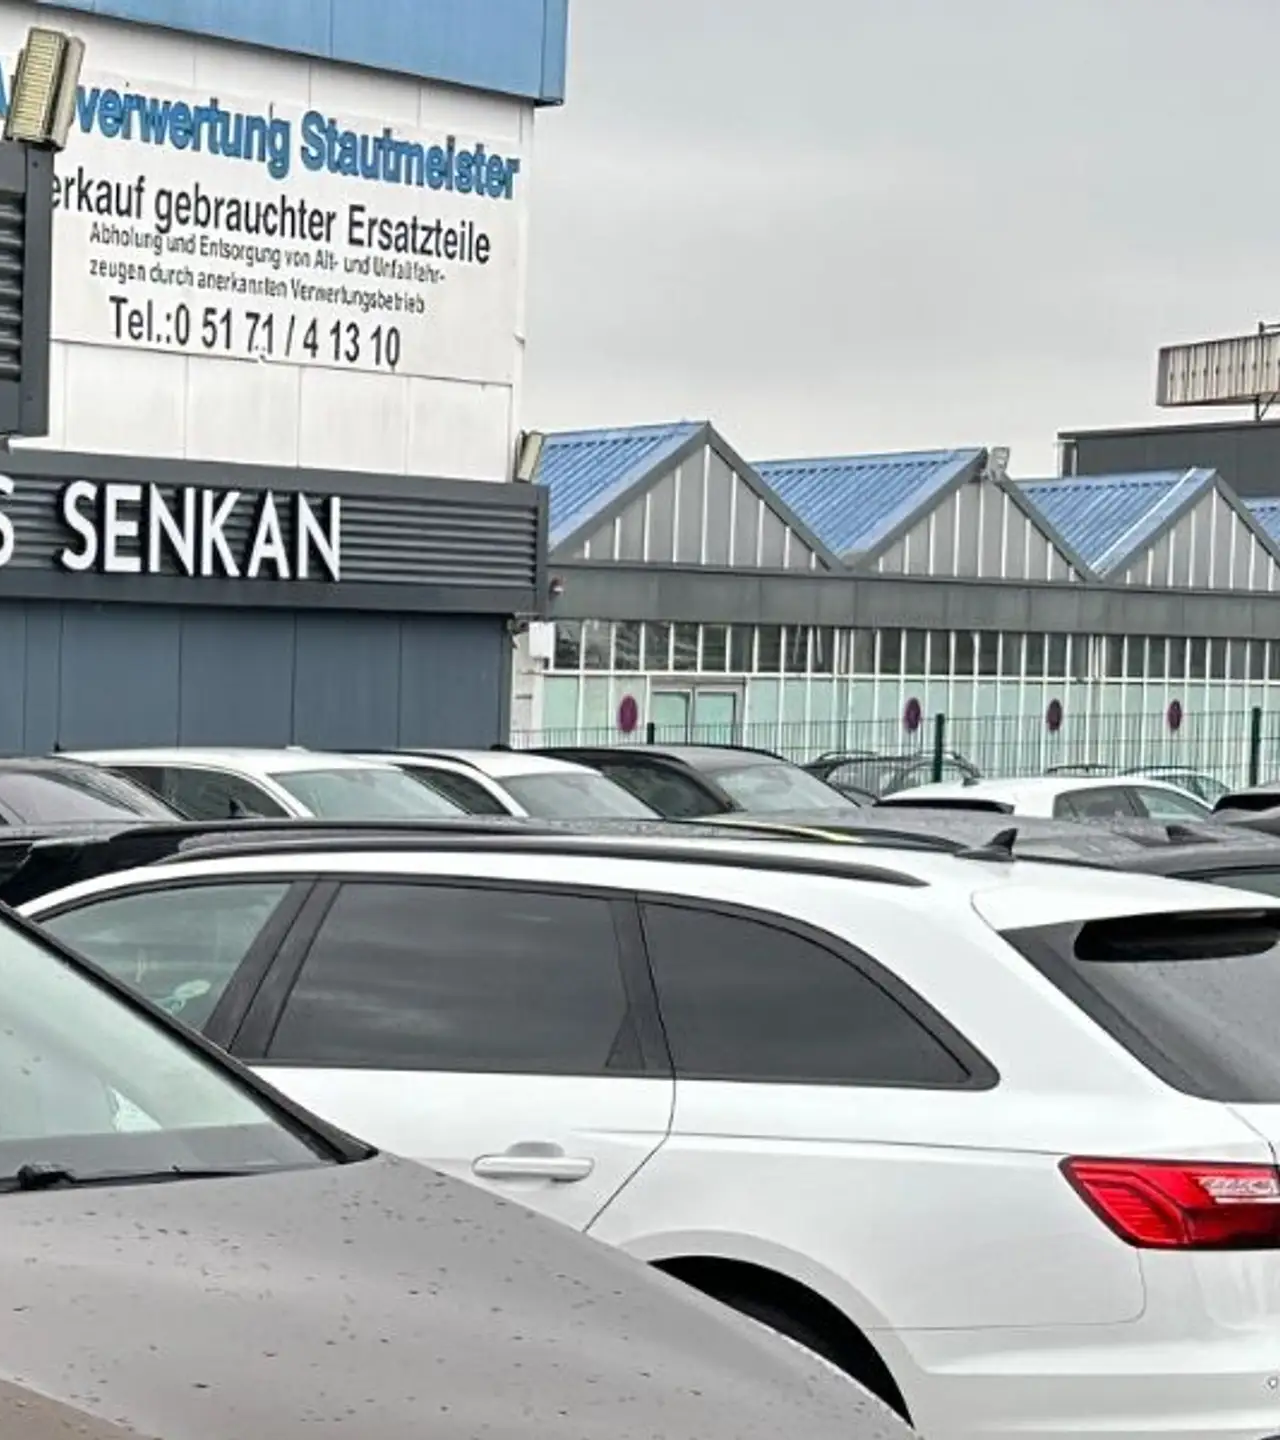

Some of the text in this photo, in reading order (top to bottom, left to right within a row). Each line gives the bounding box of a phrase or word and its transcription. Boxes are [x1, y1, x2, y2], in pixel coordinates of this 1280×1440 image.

[301, 110, 521, 200] Stautmeister
[52, 166, 491, 264] erkauf gebrauchter Ersatzteile
[90, 222, 162, 255] Abholung
[167, 234, 196, 254] und
[200, 235, 281, 270] Entsorgung
[285, 250, 311, 267] von
[344, 256, 370, 275] und
[90, 258, 146, 284] zeugen
[149, 262, 193, 286] durch
[62, 480, 341, 581] SENKAN
